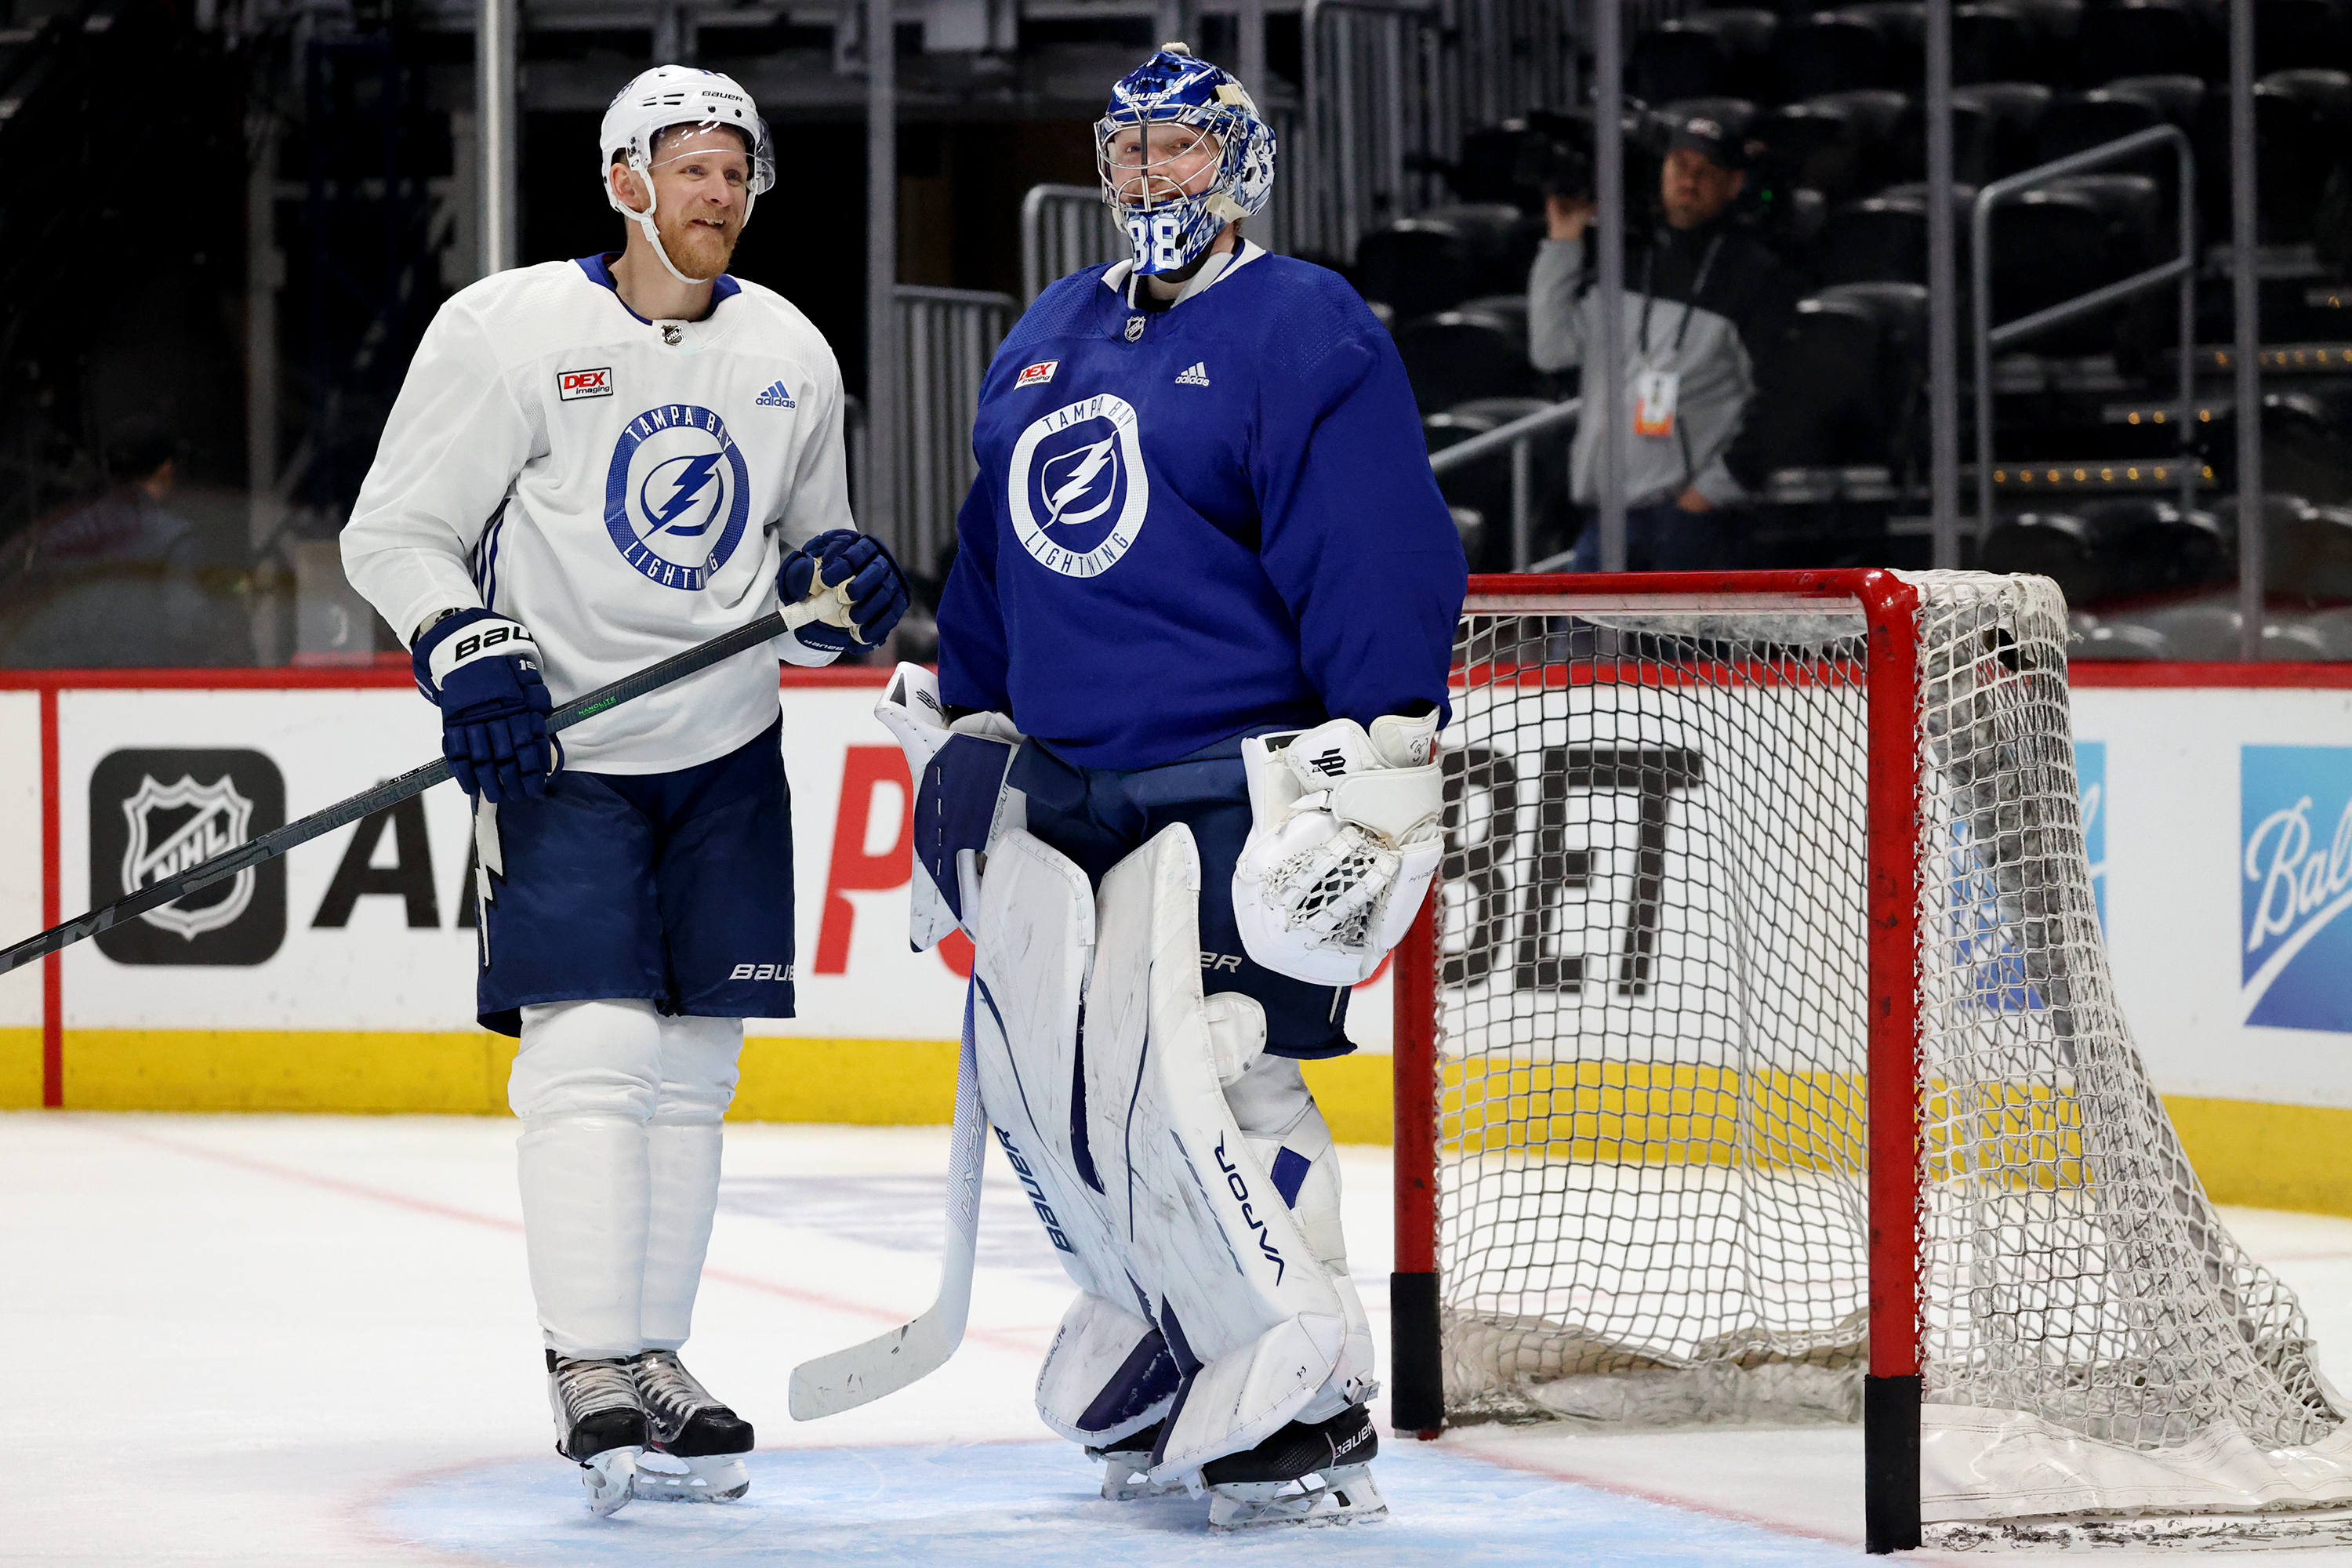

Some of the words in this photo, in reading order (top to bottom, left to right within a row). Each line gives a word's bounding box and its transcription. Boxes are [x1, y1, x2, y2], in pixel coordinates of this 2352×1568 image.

[702, 90, 743, 102] BAUER
[1121, 92, 1172, 104] BAUER
[1127, 213, 1181, 270] 88
[564, 372, 605, 389] DEX
[575, 386, 610, 394] imaging
[1019, 363, 1052, 382] DEX
[1175, 376, 1210, 387] adidas
[755, 396, 796, 408] adidas
[1043, 396, 1104, 432] TAMPA
[1108, 401, 1134, 428] BAY
[625, 405, 694, 442] TAMPA
[706, 412, 733, 452] BAY
[622, 540, 719, 589] LIGHTNIG
[1025, 531, 1129, 576] LIGHTNING
[804, 639, 845, 651] BAUER
[578, 695, 615, 715] NANOLITE
[153, 815, 231, 886] NHL
[310, 772, 481, 930] A
[1441, 746, 1704, 997] BET
[961, 1077, 982, 1223] HYPE
[993, 1125, 1077, 1256] BAUER
[1214, 1129, 1285, 1287] VAPOR
[1037, 1324, 1067, 1392] HYPERLITE
[1334, 1421, 1374, 1460] BAUER
